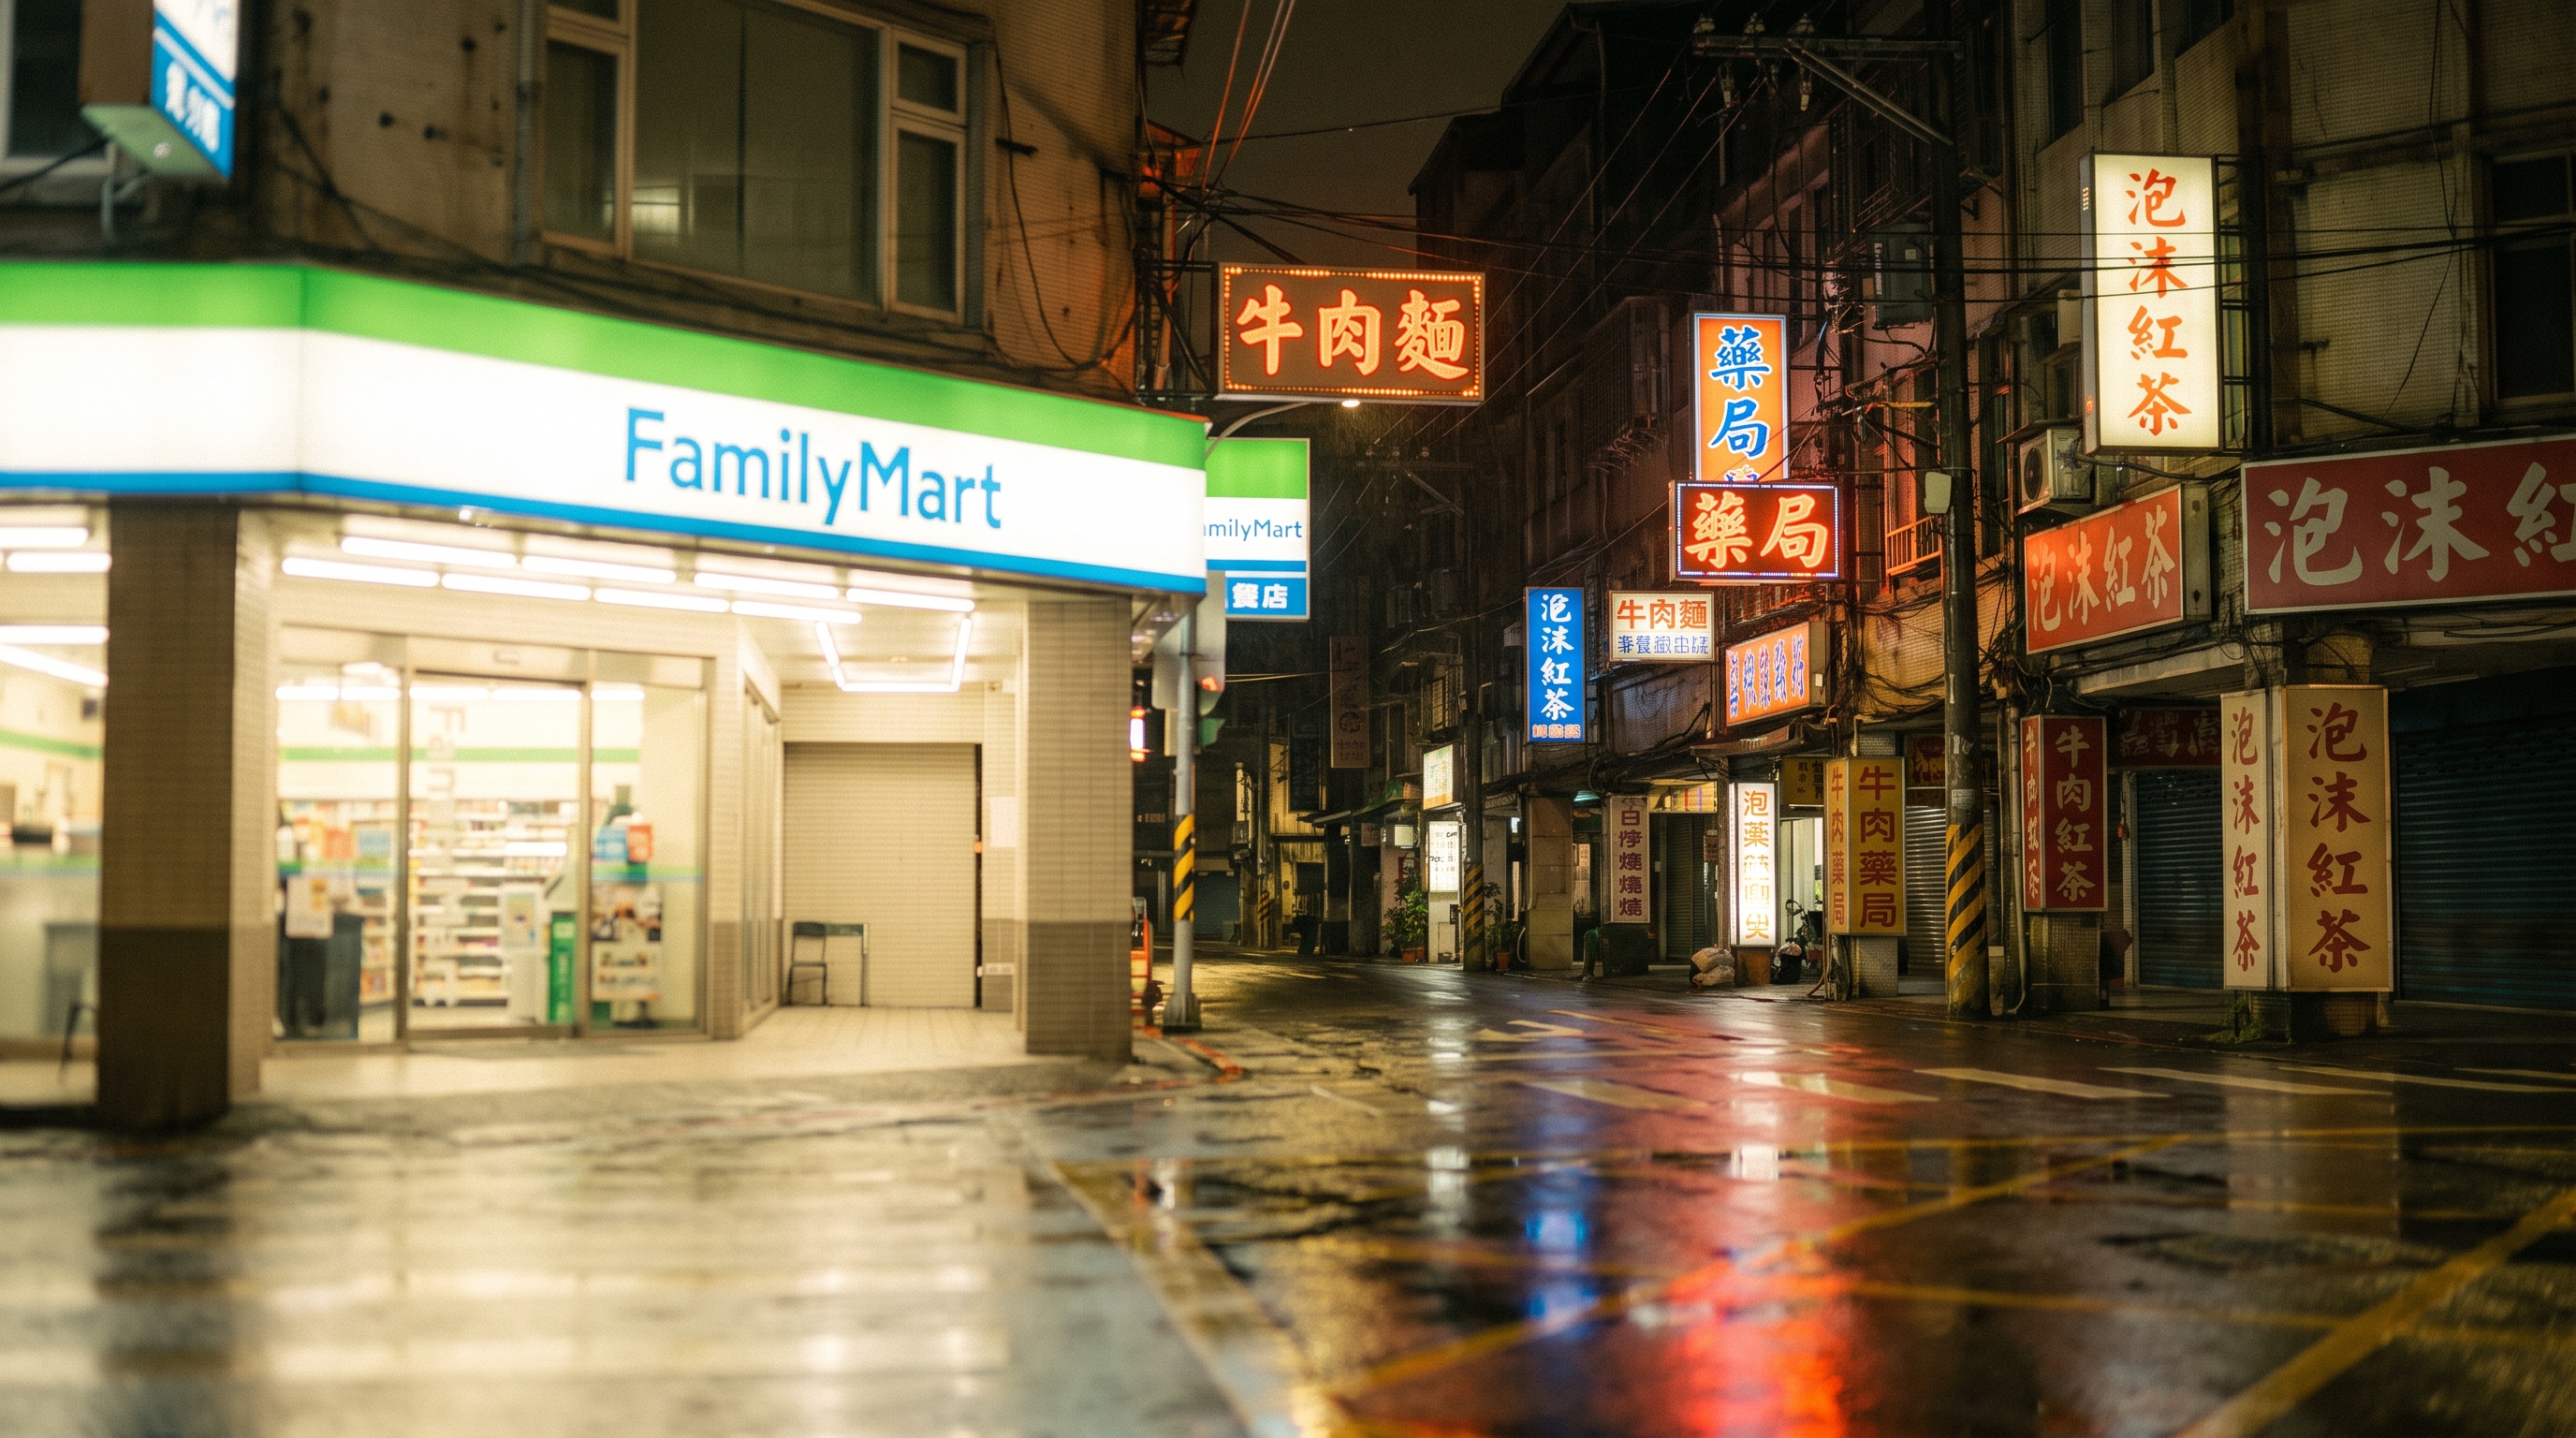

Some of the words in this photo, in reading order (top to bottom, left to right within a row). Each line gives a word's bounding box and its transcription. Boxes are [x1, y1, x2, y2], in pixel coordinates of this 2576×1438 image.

[1236, 284, 1469, 380] 牛肉麵
[2126, 169, 2191, 437] 泡沫紅茶
[1708, 325, 1771, 480] 藥局
[624, 406, 1002, 529] FamilyMart
[1204, 519, 1302, 541] milyMart
[1685, 492, 1827, 569] 藥局
[1617, 599, 1706, 629] 牛肉麵
[2031, 505, 2176, 633] 泡沫紅茶
[1541, 594, 1574, 720] 泡沫紅茶
[1859, 766, 1897, 928] 牛肉藥局
[2056, 725, 2096, 902] 牛肉紅茶
[2231, 707, 2261, 972] 泡沫紅茶
[2307, 702, 2371, 974] 泡沫紅茶
